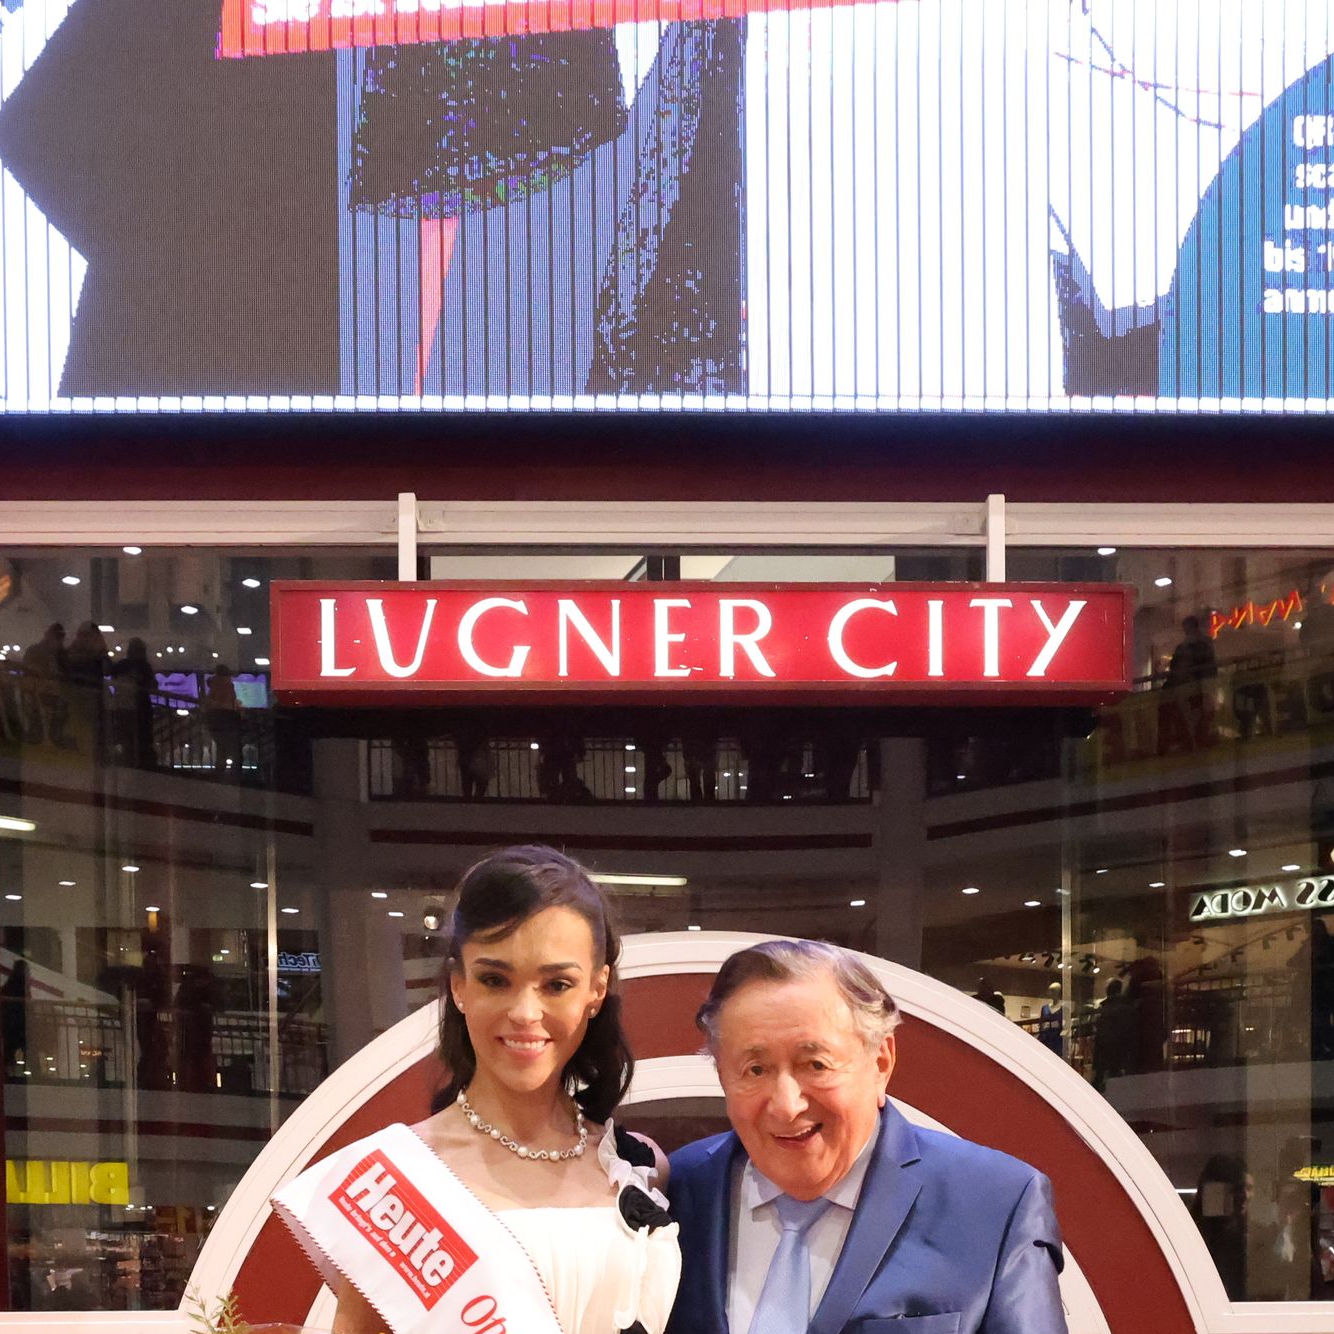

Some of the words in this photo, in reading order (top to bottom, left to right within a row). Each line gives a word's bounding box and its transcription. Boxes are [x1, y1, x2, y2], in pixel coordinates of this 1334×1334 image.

[1263, 238, 1305, 273] bis
[319, 597, 776, 678] LUGNER
[828, 597, 1088, 678] CITY
[345, 1161, 455, 1287] Heute
